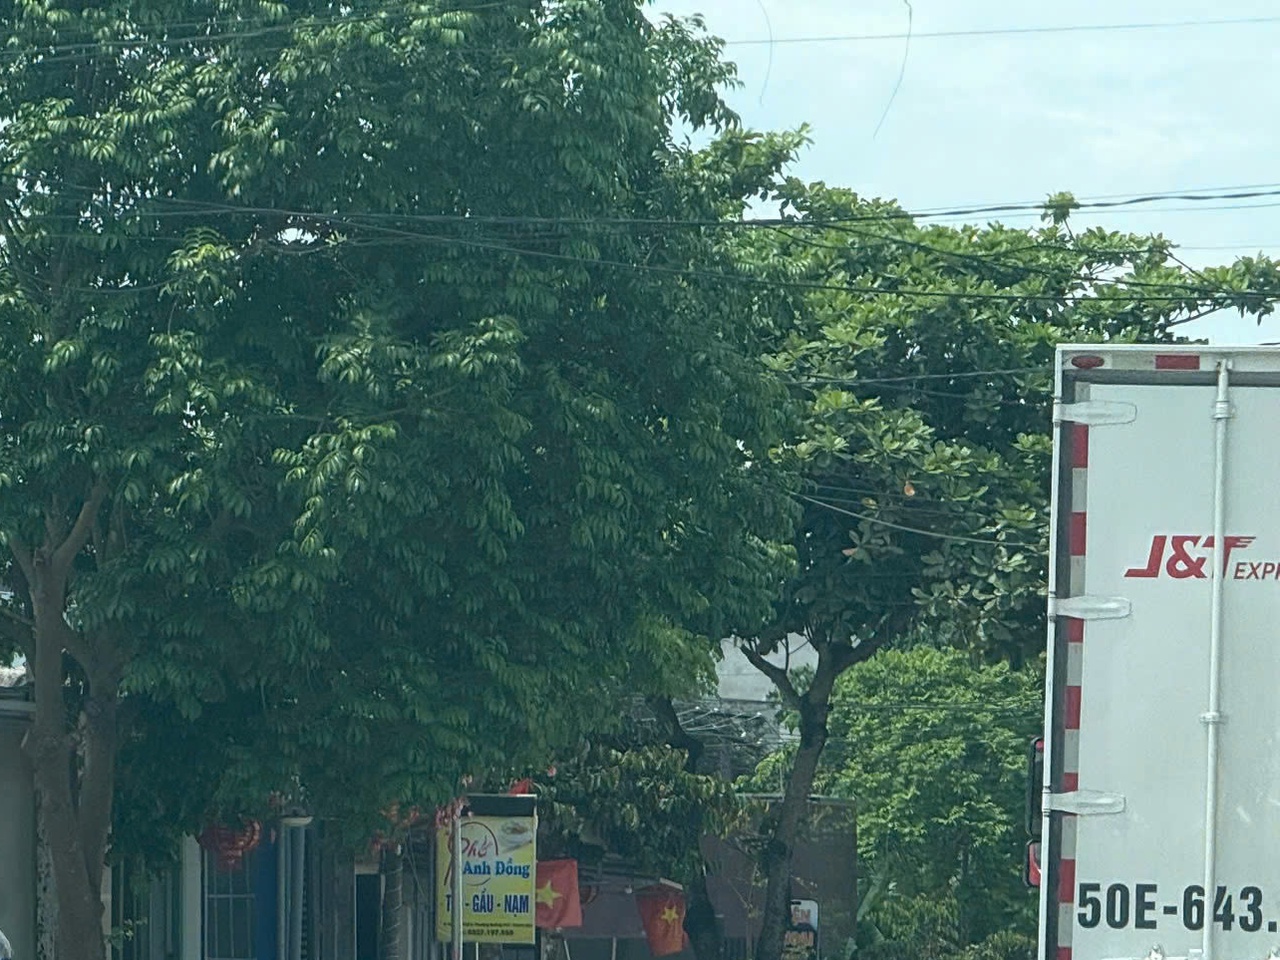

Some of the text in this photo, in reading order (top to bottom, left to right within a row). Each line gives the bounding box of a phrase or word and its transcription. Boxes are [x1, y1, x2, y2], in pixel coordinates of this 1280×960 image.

[1124, 535, 1280, 580] J&T EXP
[463, 860, 491, 875] Anh
[504, 894, 529, 917] NẠM
